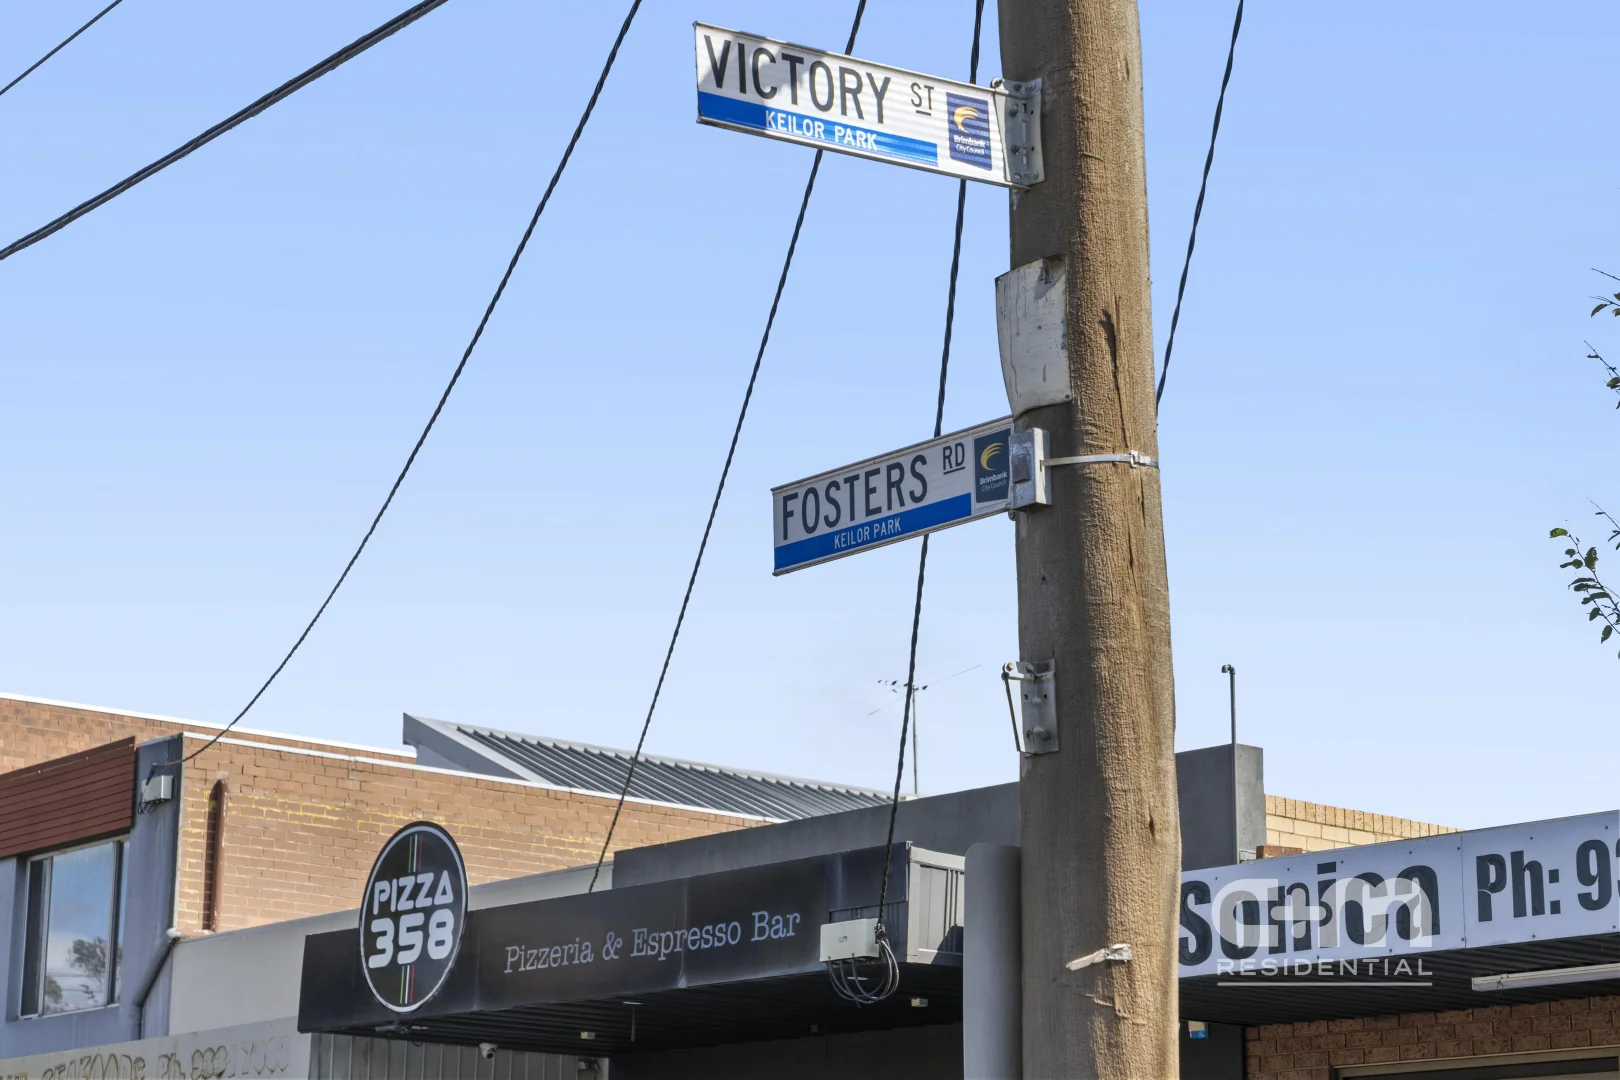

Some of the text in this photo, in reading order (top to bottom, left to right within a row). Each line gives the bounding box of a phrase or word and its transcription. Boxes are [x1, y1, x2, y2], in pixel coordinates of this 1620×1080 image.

[704, 35, 934, 124] VICTORY ST
[765, 110, 877, 150] KEILOR PARK
[953, 135, 986, 148] Brimbank
[782, 442, 965, 541] FOSTERS RD
[980, 471, 1008, 485] Brimbank
[981, 479, 1007, 492] City Council
[834, 517, 901, 549] KEILOR PARK
[373, 869, 453, 915] PIZZA
[1476, 850, 1561, 923] Ph:
[1576, 838, 1620, 911] 9
[368, 909, 455, 968] 358
[504, 910, 801, 974] Pizzeria & Espresso Bar
